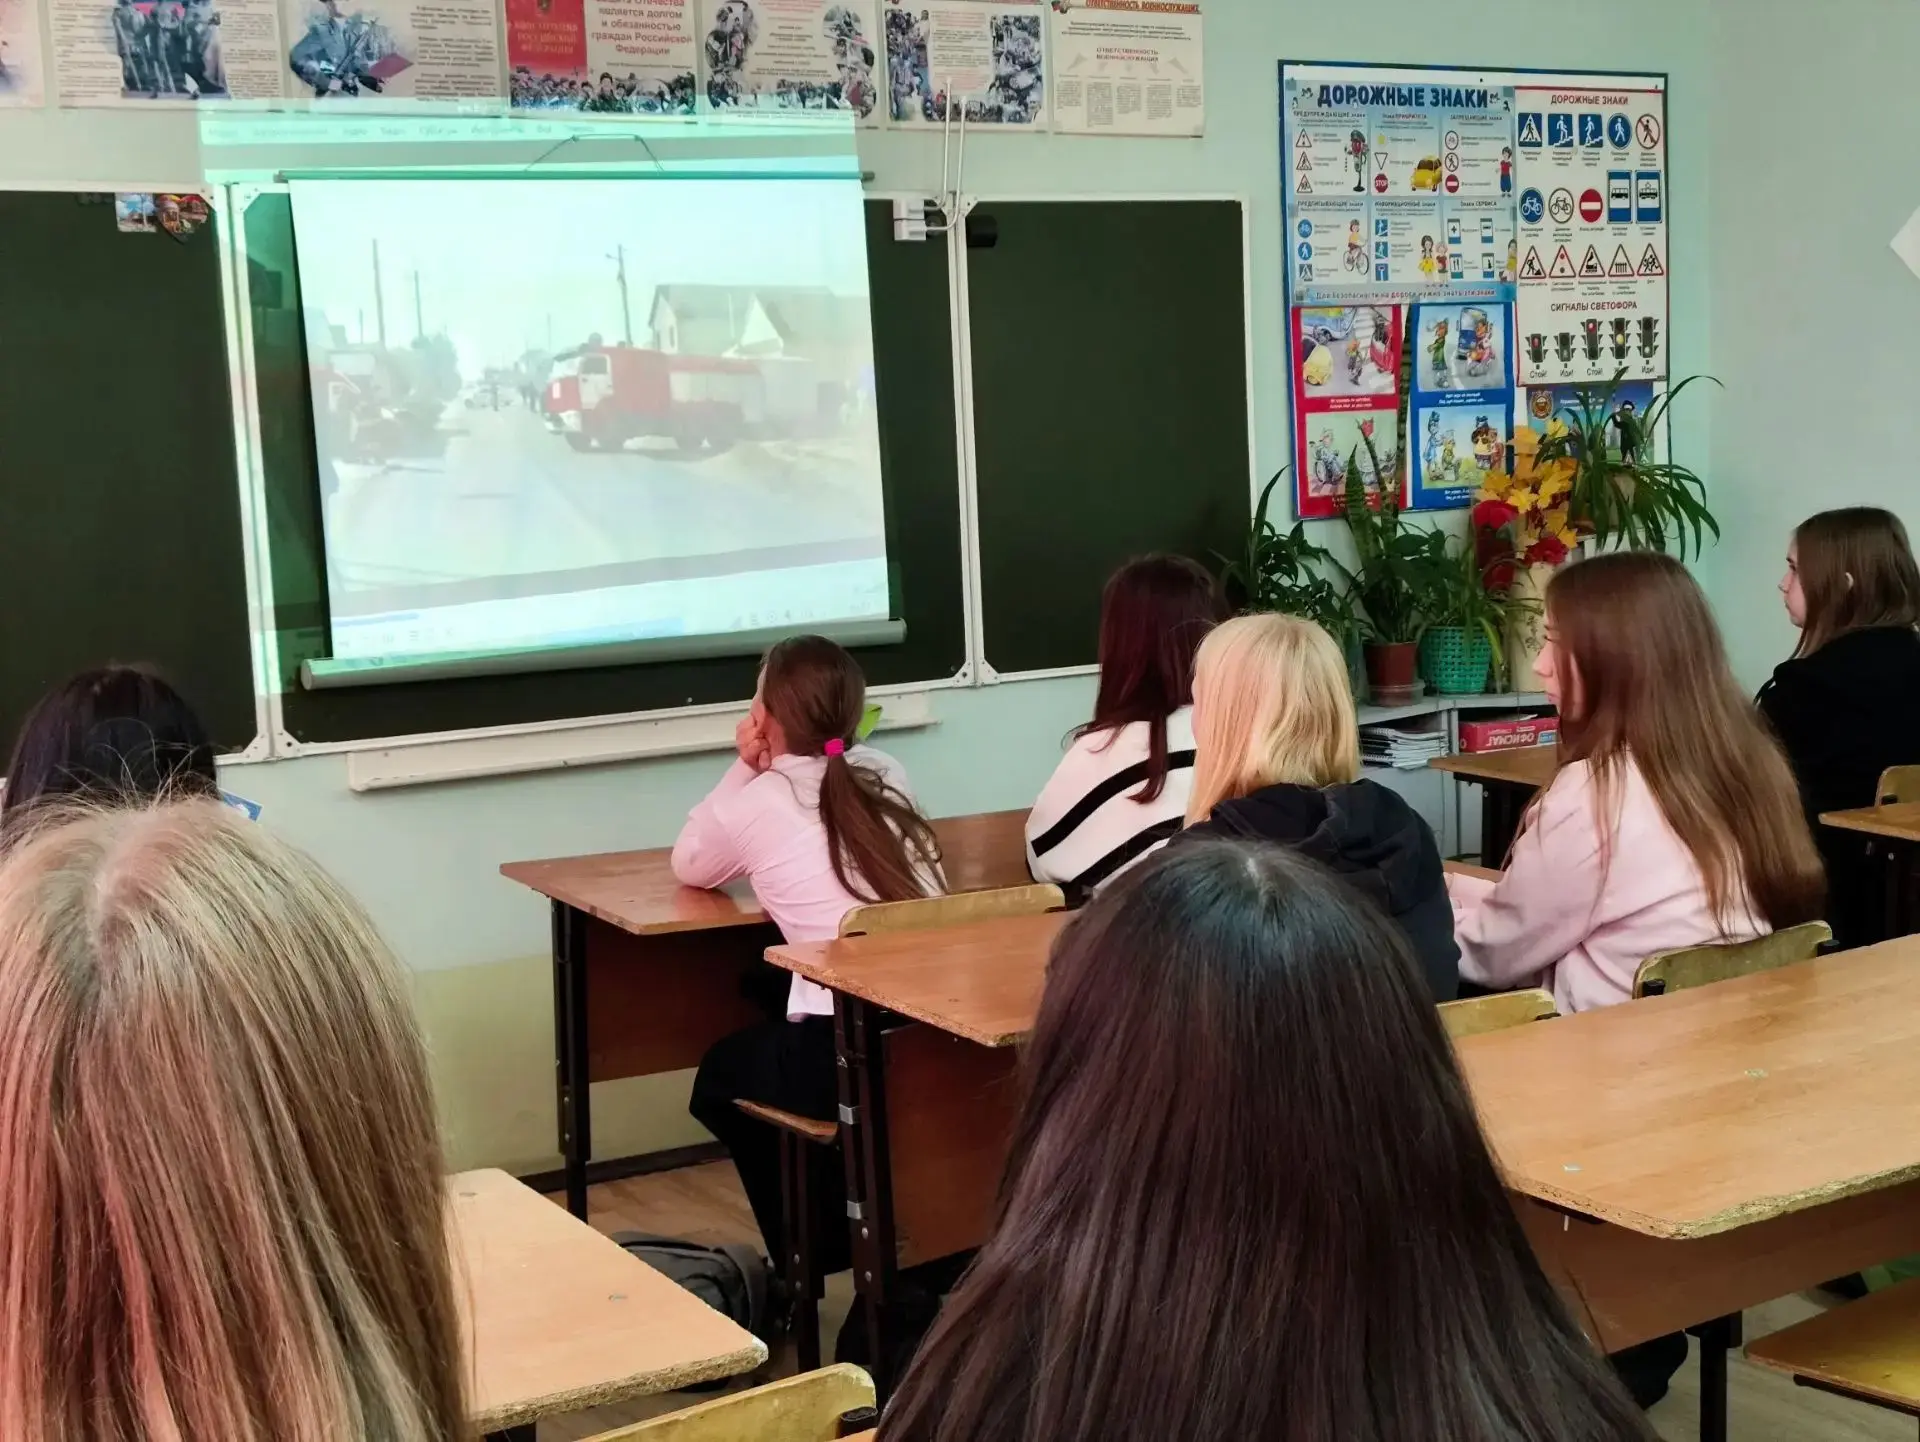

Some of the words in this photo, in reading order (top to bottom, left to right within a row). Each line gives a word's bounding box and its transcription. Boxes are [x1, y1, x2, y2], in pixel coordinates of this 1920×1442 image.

[599, 8, 644, 18] является
[646, 11, 683, 20] долгом
[601, 20, 608, 28] и
[611, 19, 682, 32] обязанностью
[591, 31, 632, 42] граждан
[635, 32, 692, 44] Российской
[615, 43, 671, 56] Федерации
[1317, 84, 1425, 108] ДОРОЖНЫЕ
[1429, 88, 1488, 108] ЗНАКИ
[1550, 95, 1600, 105] ДОРОЖНЫЕ
[1602, 96, 1629, 105] ЗНАКИ
[1375, 179, 1387, 187] STOP
[1550, 302, 1589, 312] СИГНАЛЫ
[1590, 301, 1638, 311] СВЕТОФОРА
[1529, 369, 1548, 379] Стой!
[1559, 369, 1574, 378] Иди!
[1586, 368, 1603, 377] Стой!
[1641, 365, 1656, 374] Иди!
[1485, 733, 1535, 746] ОФИСМАГ
